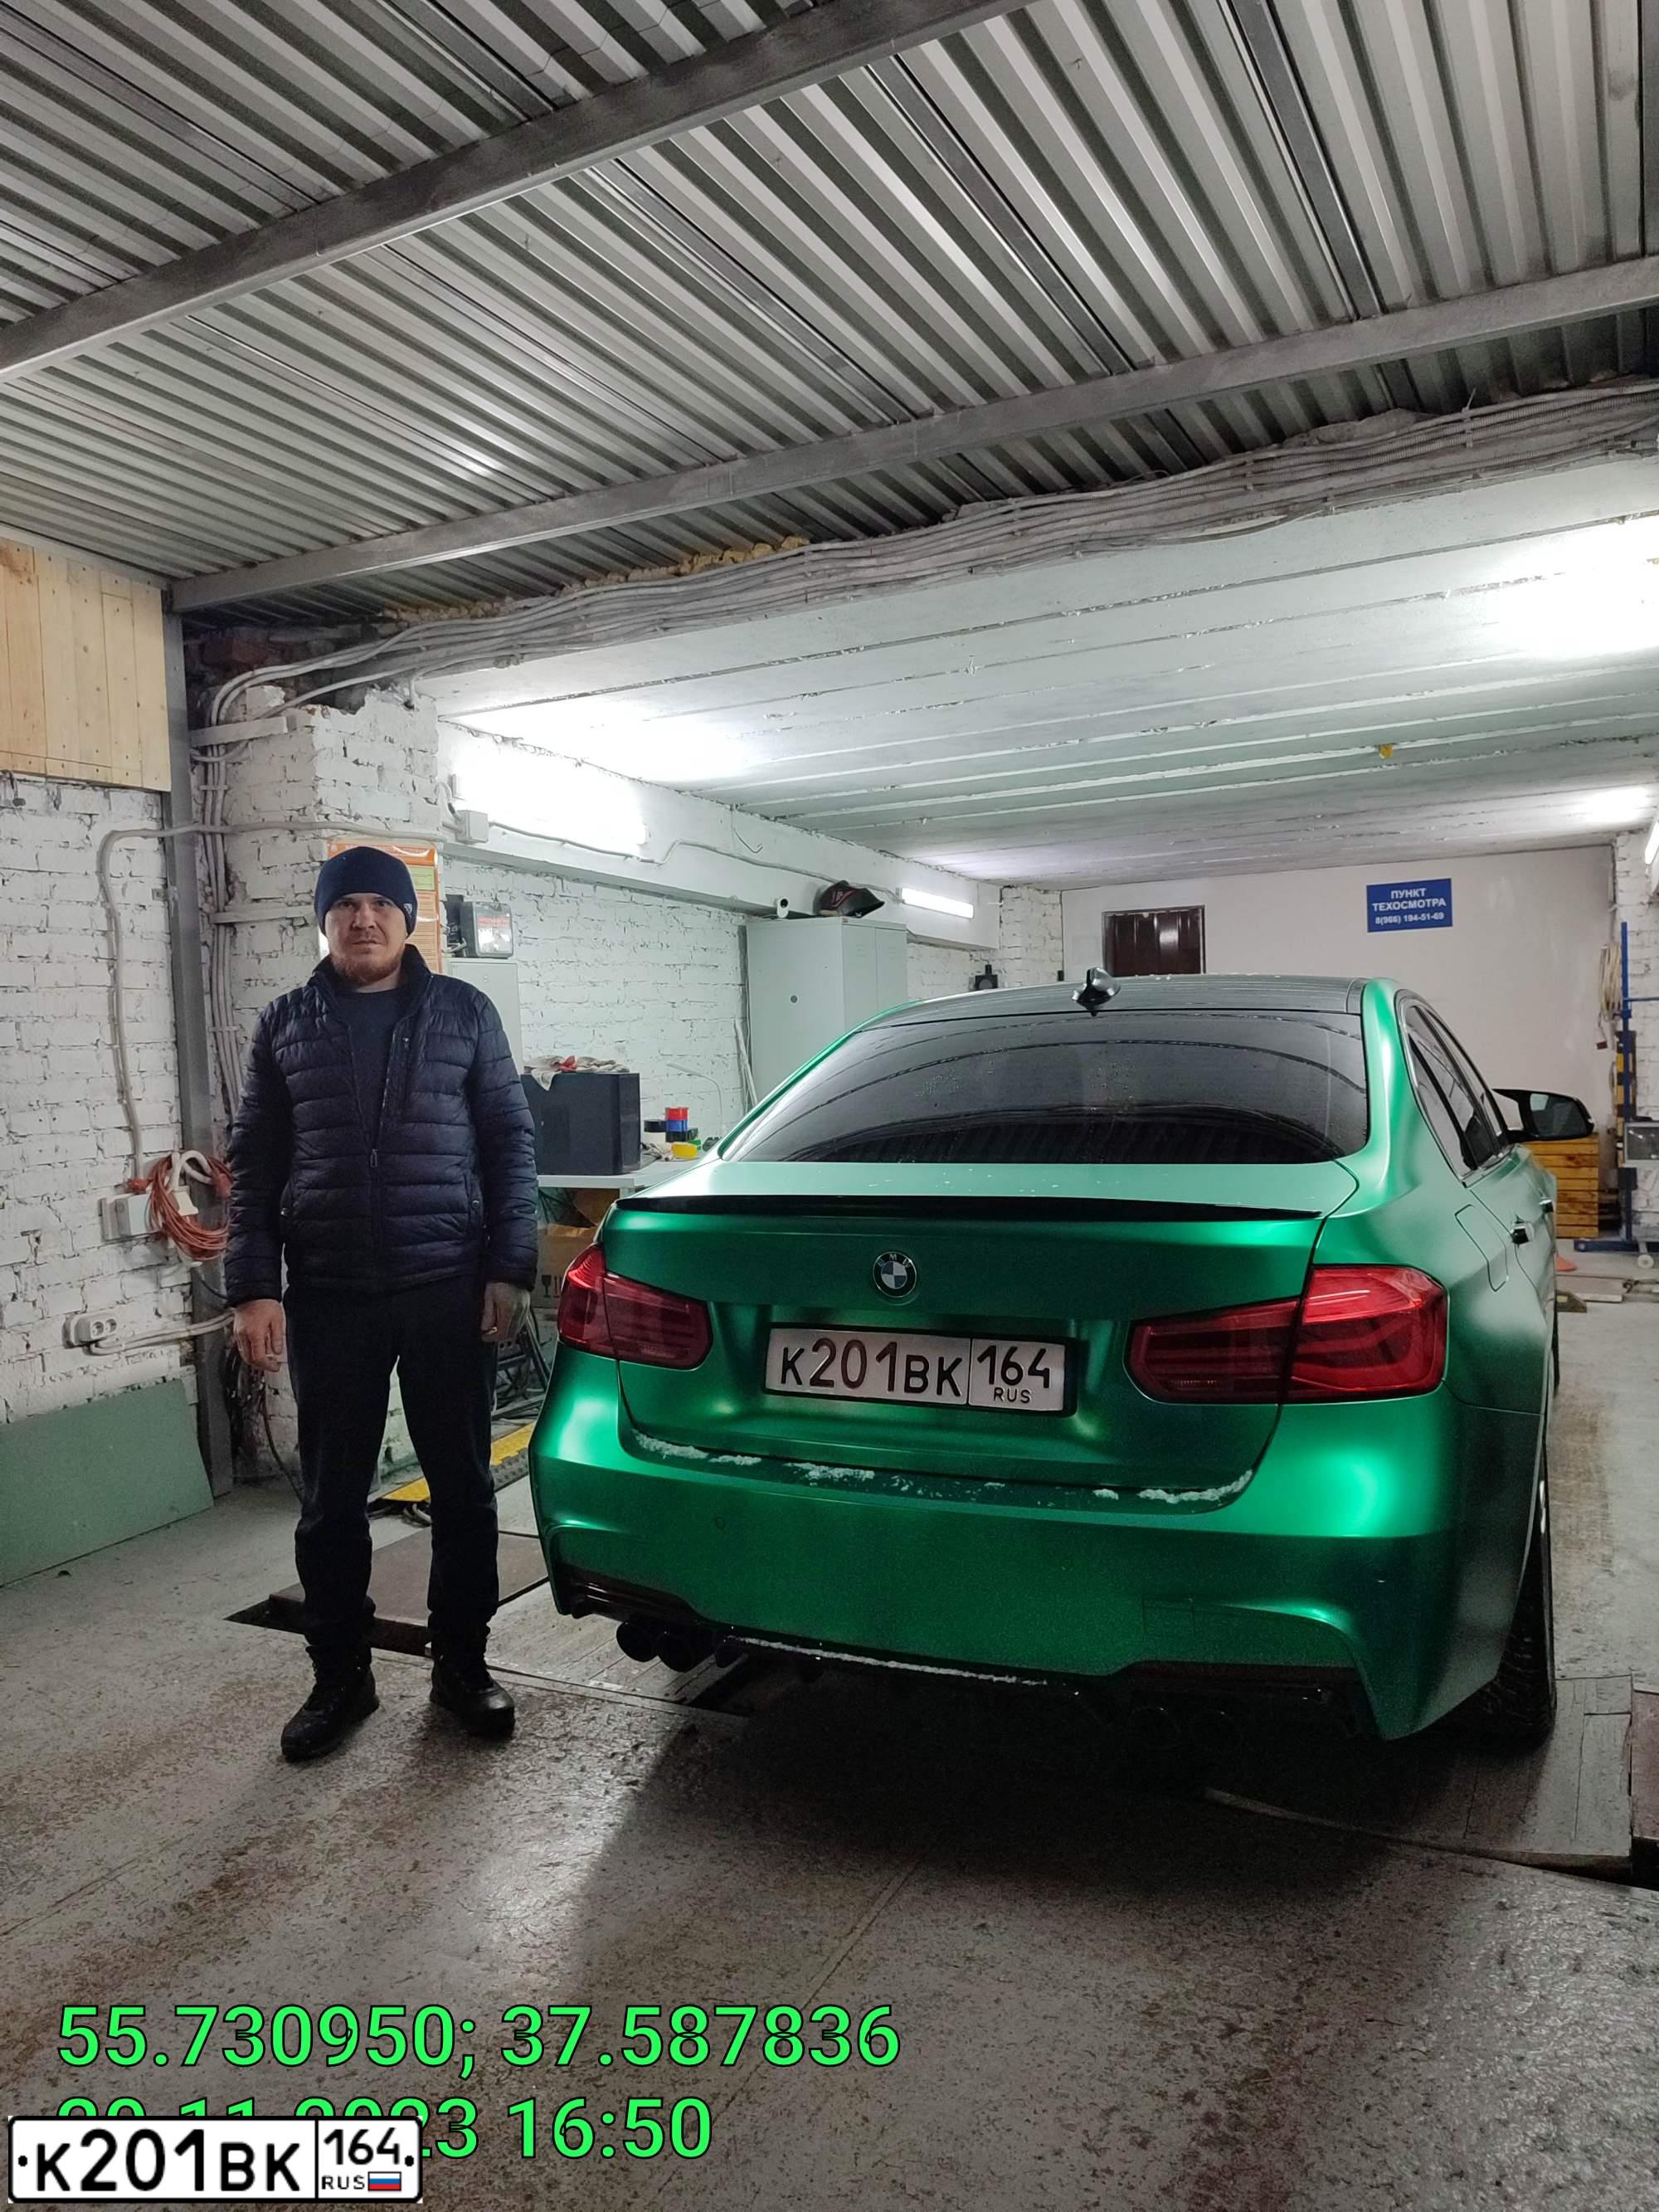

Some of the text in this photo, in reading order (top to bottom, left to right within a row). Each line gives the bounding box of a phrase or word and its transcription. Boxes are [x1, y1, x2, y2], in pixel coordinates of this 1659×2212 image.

[1390, 888, 1427, 899] ПУНКТ
[1372, 898, 1447, 912] ТЕХОСМОТРА
[976, 1344, 1051, 1389] 164
[993, 1386, 1033, 1404] RUS
